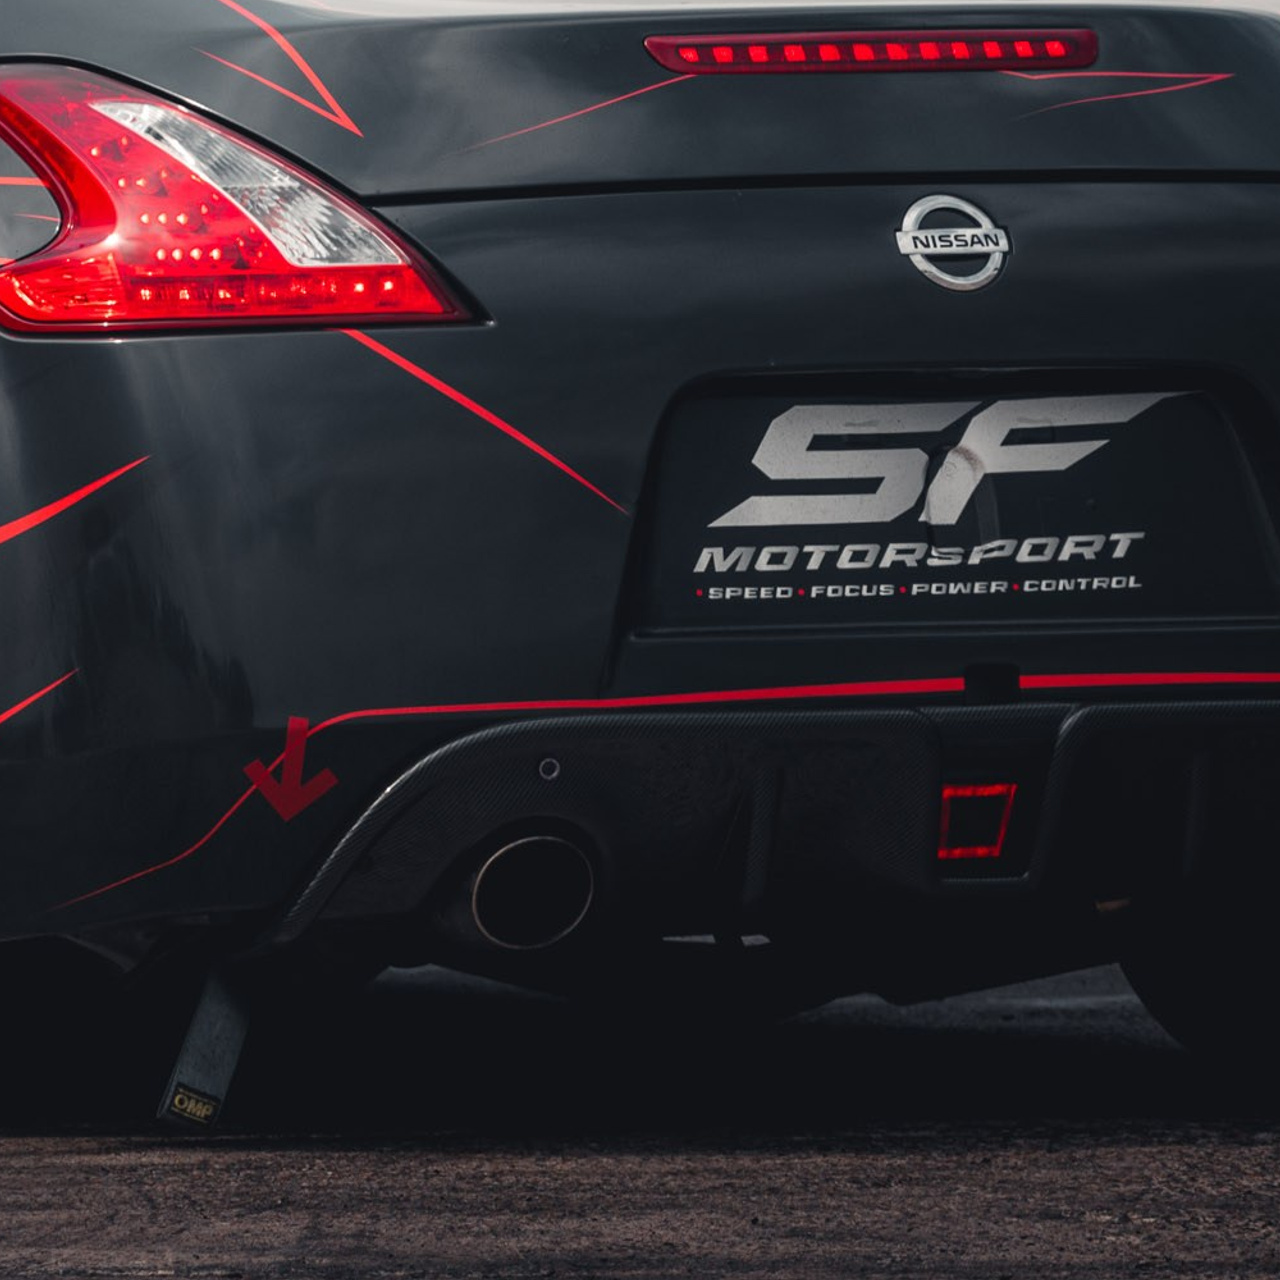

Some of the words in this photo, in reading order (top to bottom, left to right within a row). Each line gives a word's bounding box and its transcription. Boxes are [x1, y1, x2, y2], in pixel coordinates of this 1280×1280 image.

[911, 233, 1001, 249] NISSAN
[707, 391, 1200, 527] SF
[693, 531, 1146, 573] MOTORSPORT
[708, 586, 793, 600] SPEED
[810, 583, 896, 599] FOCUS
[911, 580, 1010, 596] POWER
[1023, 575, 1143, 593] CONTROL
[174, 1093, 214, 1118] OMP
